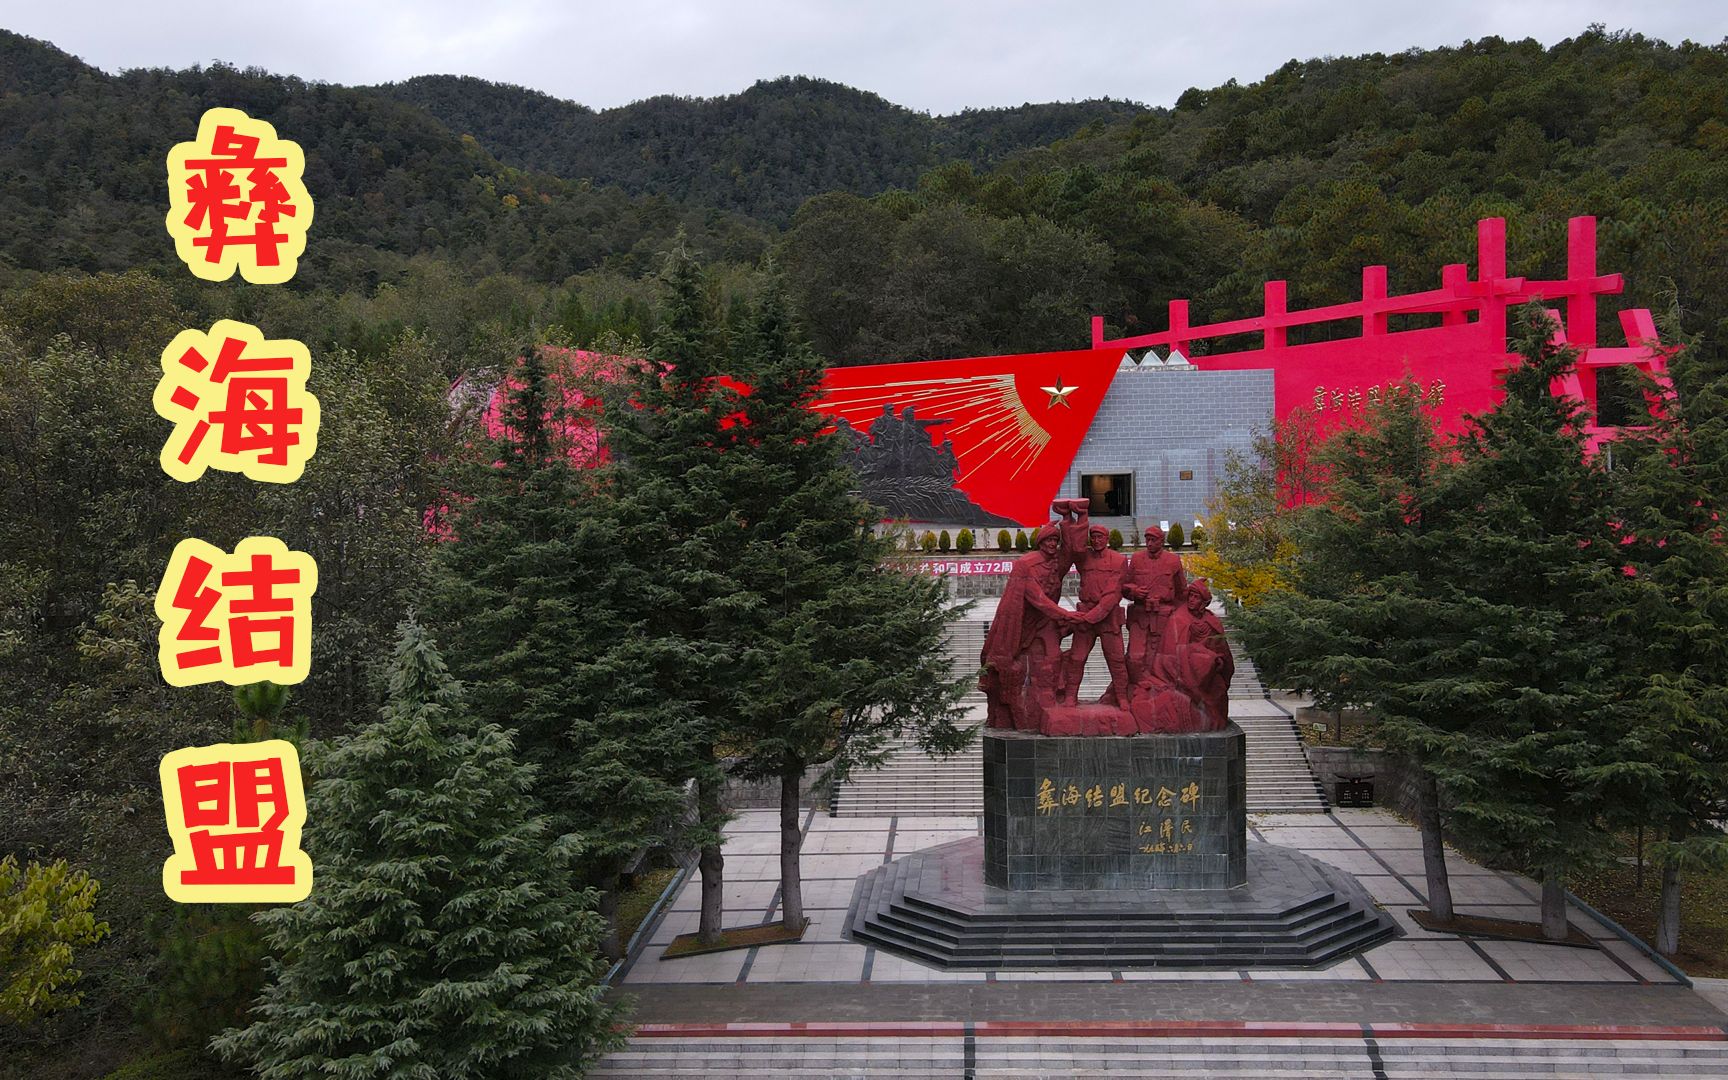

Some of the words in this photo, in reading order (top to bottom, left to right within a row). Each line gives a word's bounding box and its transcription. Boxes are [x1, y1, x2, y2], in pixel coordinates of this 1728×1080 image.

[1037, 778, 1201, 816] 彝海结盟纪念碑
